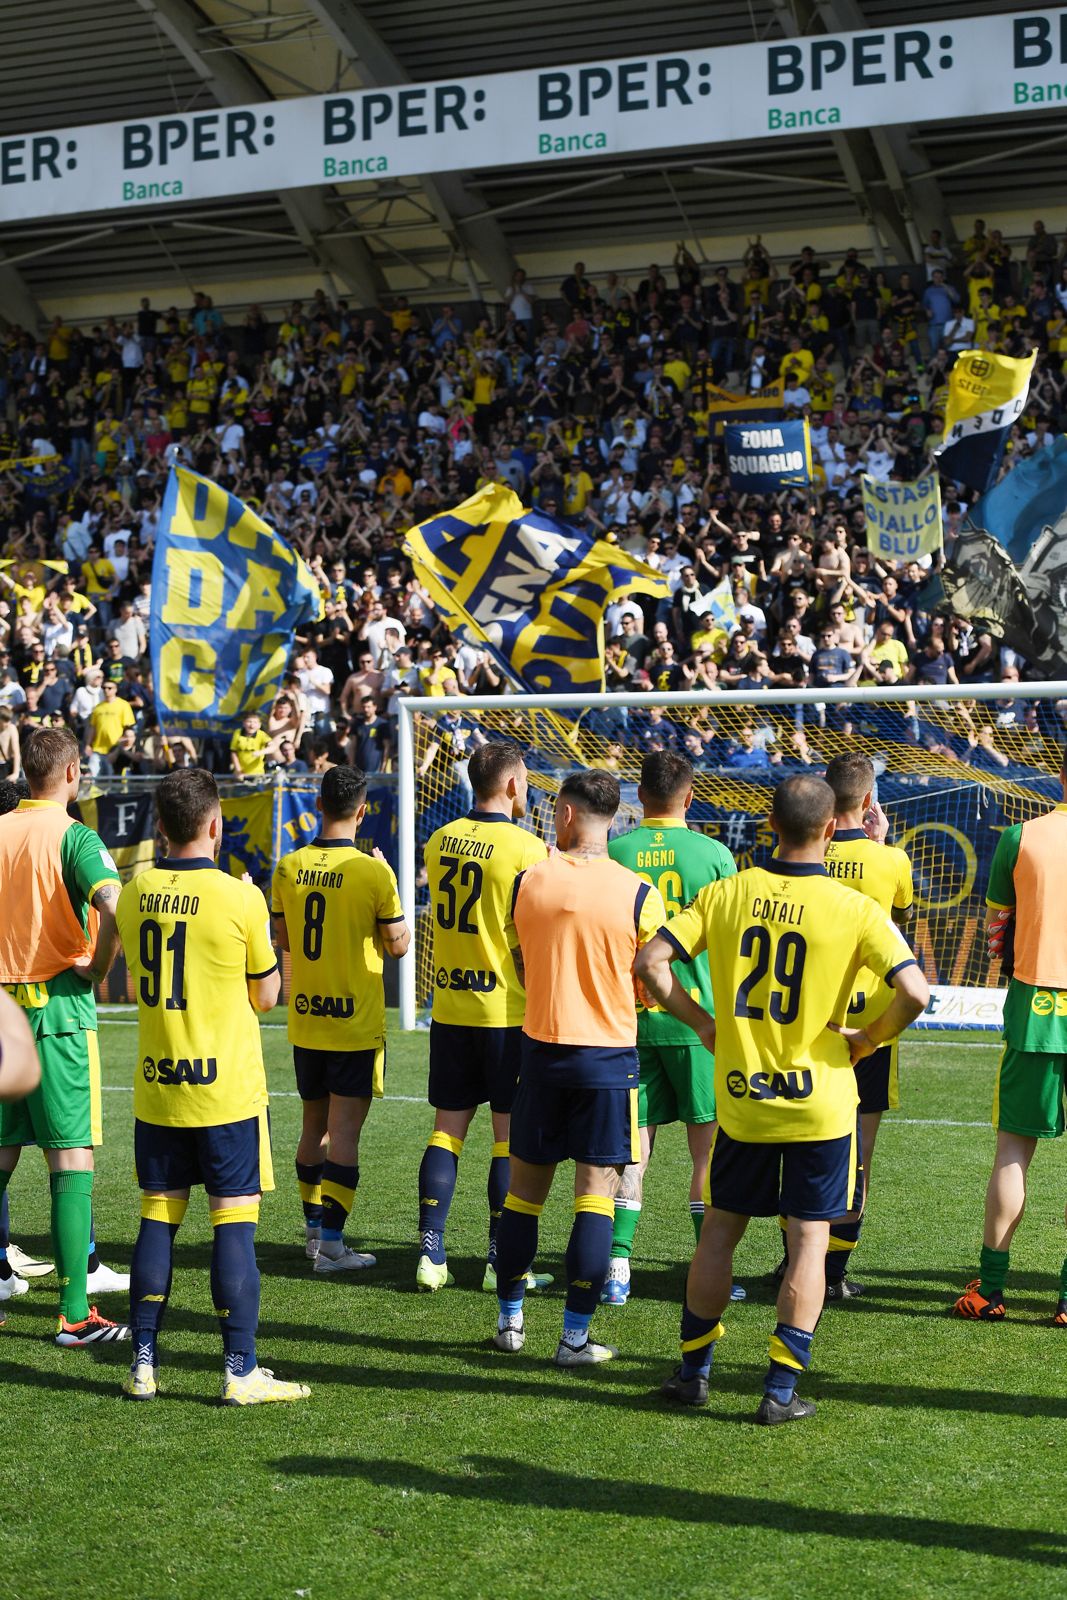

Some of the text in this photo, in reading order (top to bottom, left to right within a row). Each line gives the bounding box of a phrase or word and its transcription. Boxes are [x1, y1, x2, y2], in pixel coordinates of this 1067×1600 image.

[767, 30, 954, 96] BPER:
[538, 58, 711, 121] BPER:
[1013, 82, 1067, 104] Ban
[323, 84, 487, 145] BPER:
[767, 107, 842, 130] Banca
[122, 110, 275, 170] BPER:
[538, 131, 607, 154] Banca
[323, 156, 388, 178] Banca
[122, 179, 183, 201] Banca
[740, 428, 785, 449] ZONA
[729, 450, 804, 475] SQUAGLIO
[865, 503, 938, 533] GIALLO
[879, 532, 920, 556] BLU
[440, 835, 494, 860] STRIZZOLO
[637, 849, 675, 868] GAGNO
[296, 869, 343, 889] SANTORO
[824, 861, 863, 879] REFFI
[139, 893, 199, 916] CORRADO
[436, 855, 484, 935] 32
[636, 870, 683, 920] 6
[752, 897, 804, 925] COTALI
[303, 891, 326, 962] 8
[139, 918, 187, 1011] 91
[734, 925, 807, 1025] 29
[449, 967, 497, 993] SAU
[310, 994, 355, 1019] SAU
[157, 1057, 218, 1086] SAU
[748, 1069, 814, 1100] SAU
